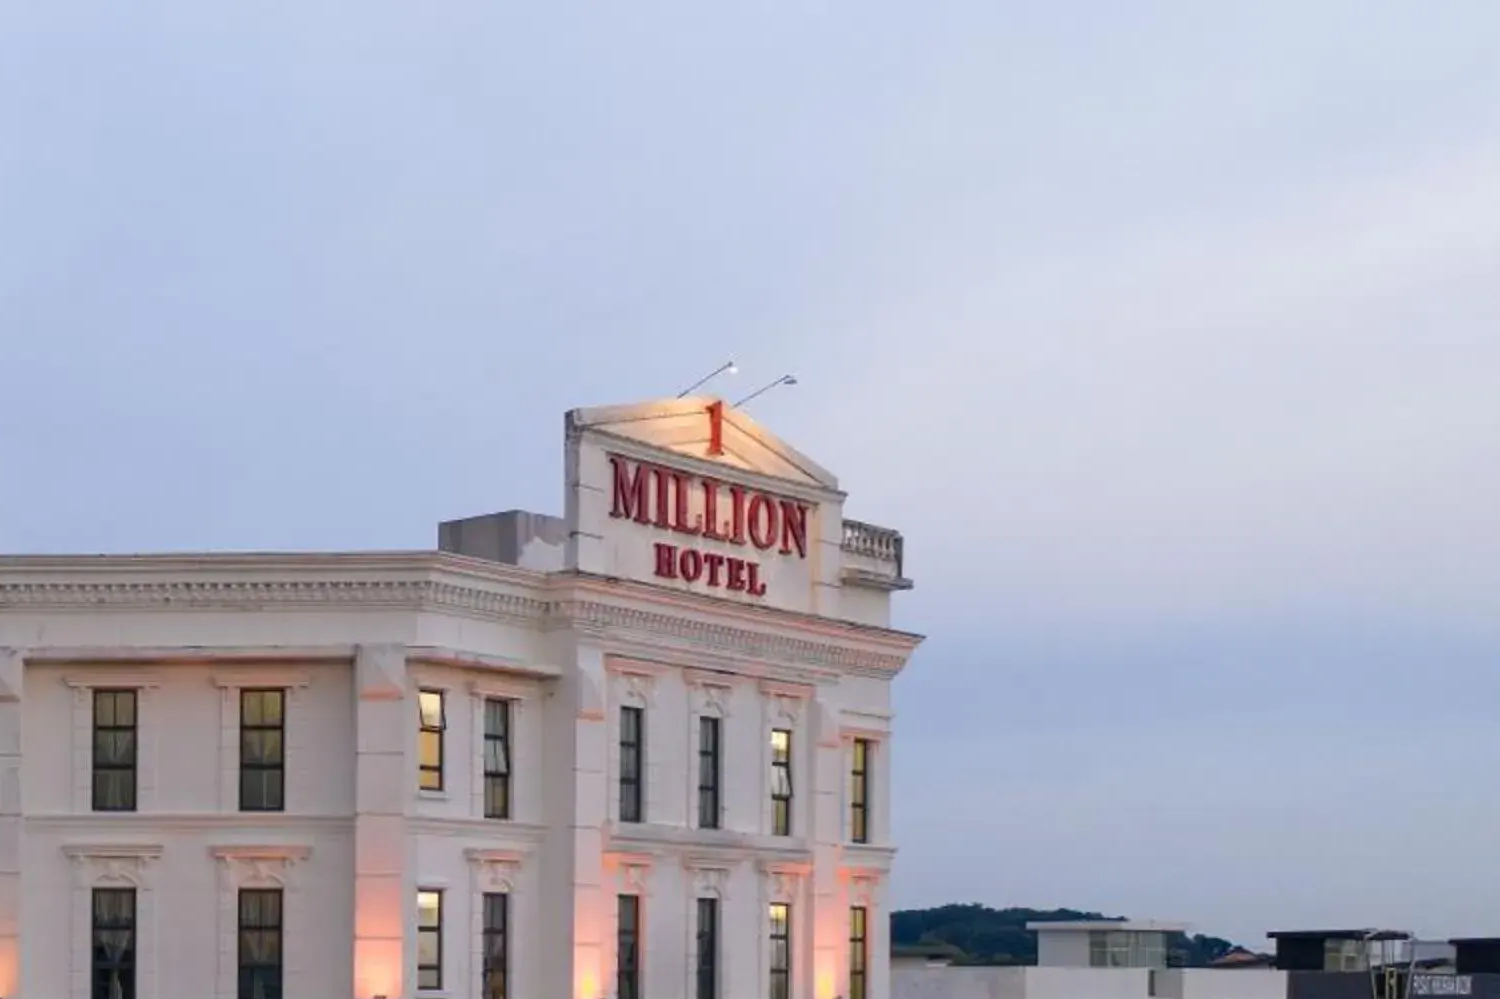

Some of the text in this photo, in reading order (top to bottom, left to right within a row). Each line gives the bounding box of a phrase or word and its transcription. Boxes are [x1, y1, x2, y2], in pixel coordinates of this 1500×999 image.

[705, 400, 724, 455] 1
[608, 454, 810, 558] MILLION
[653, 543, 767, 596] HOTEL
